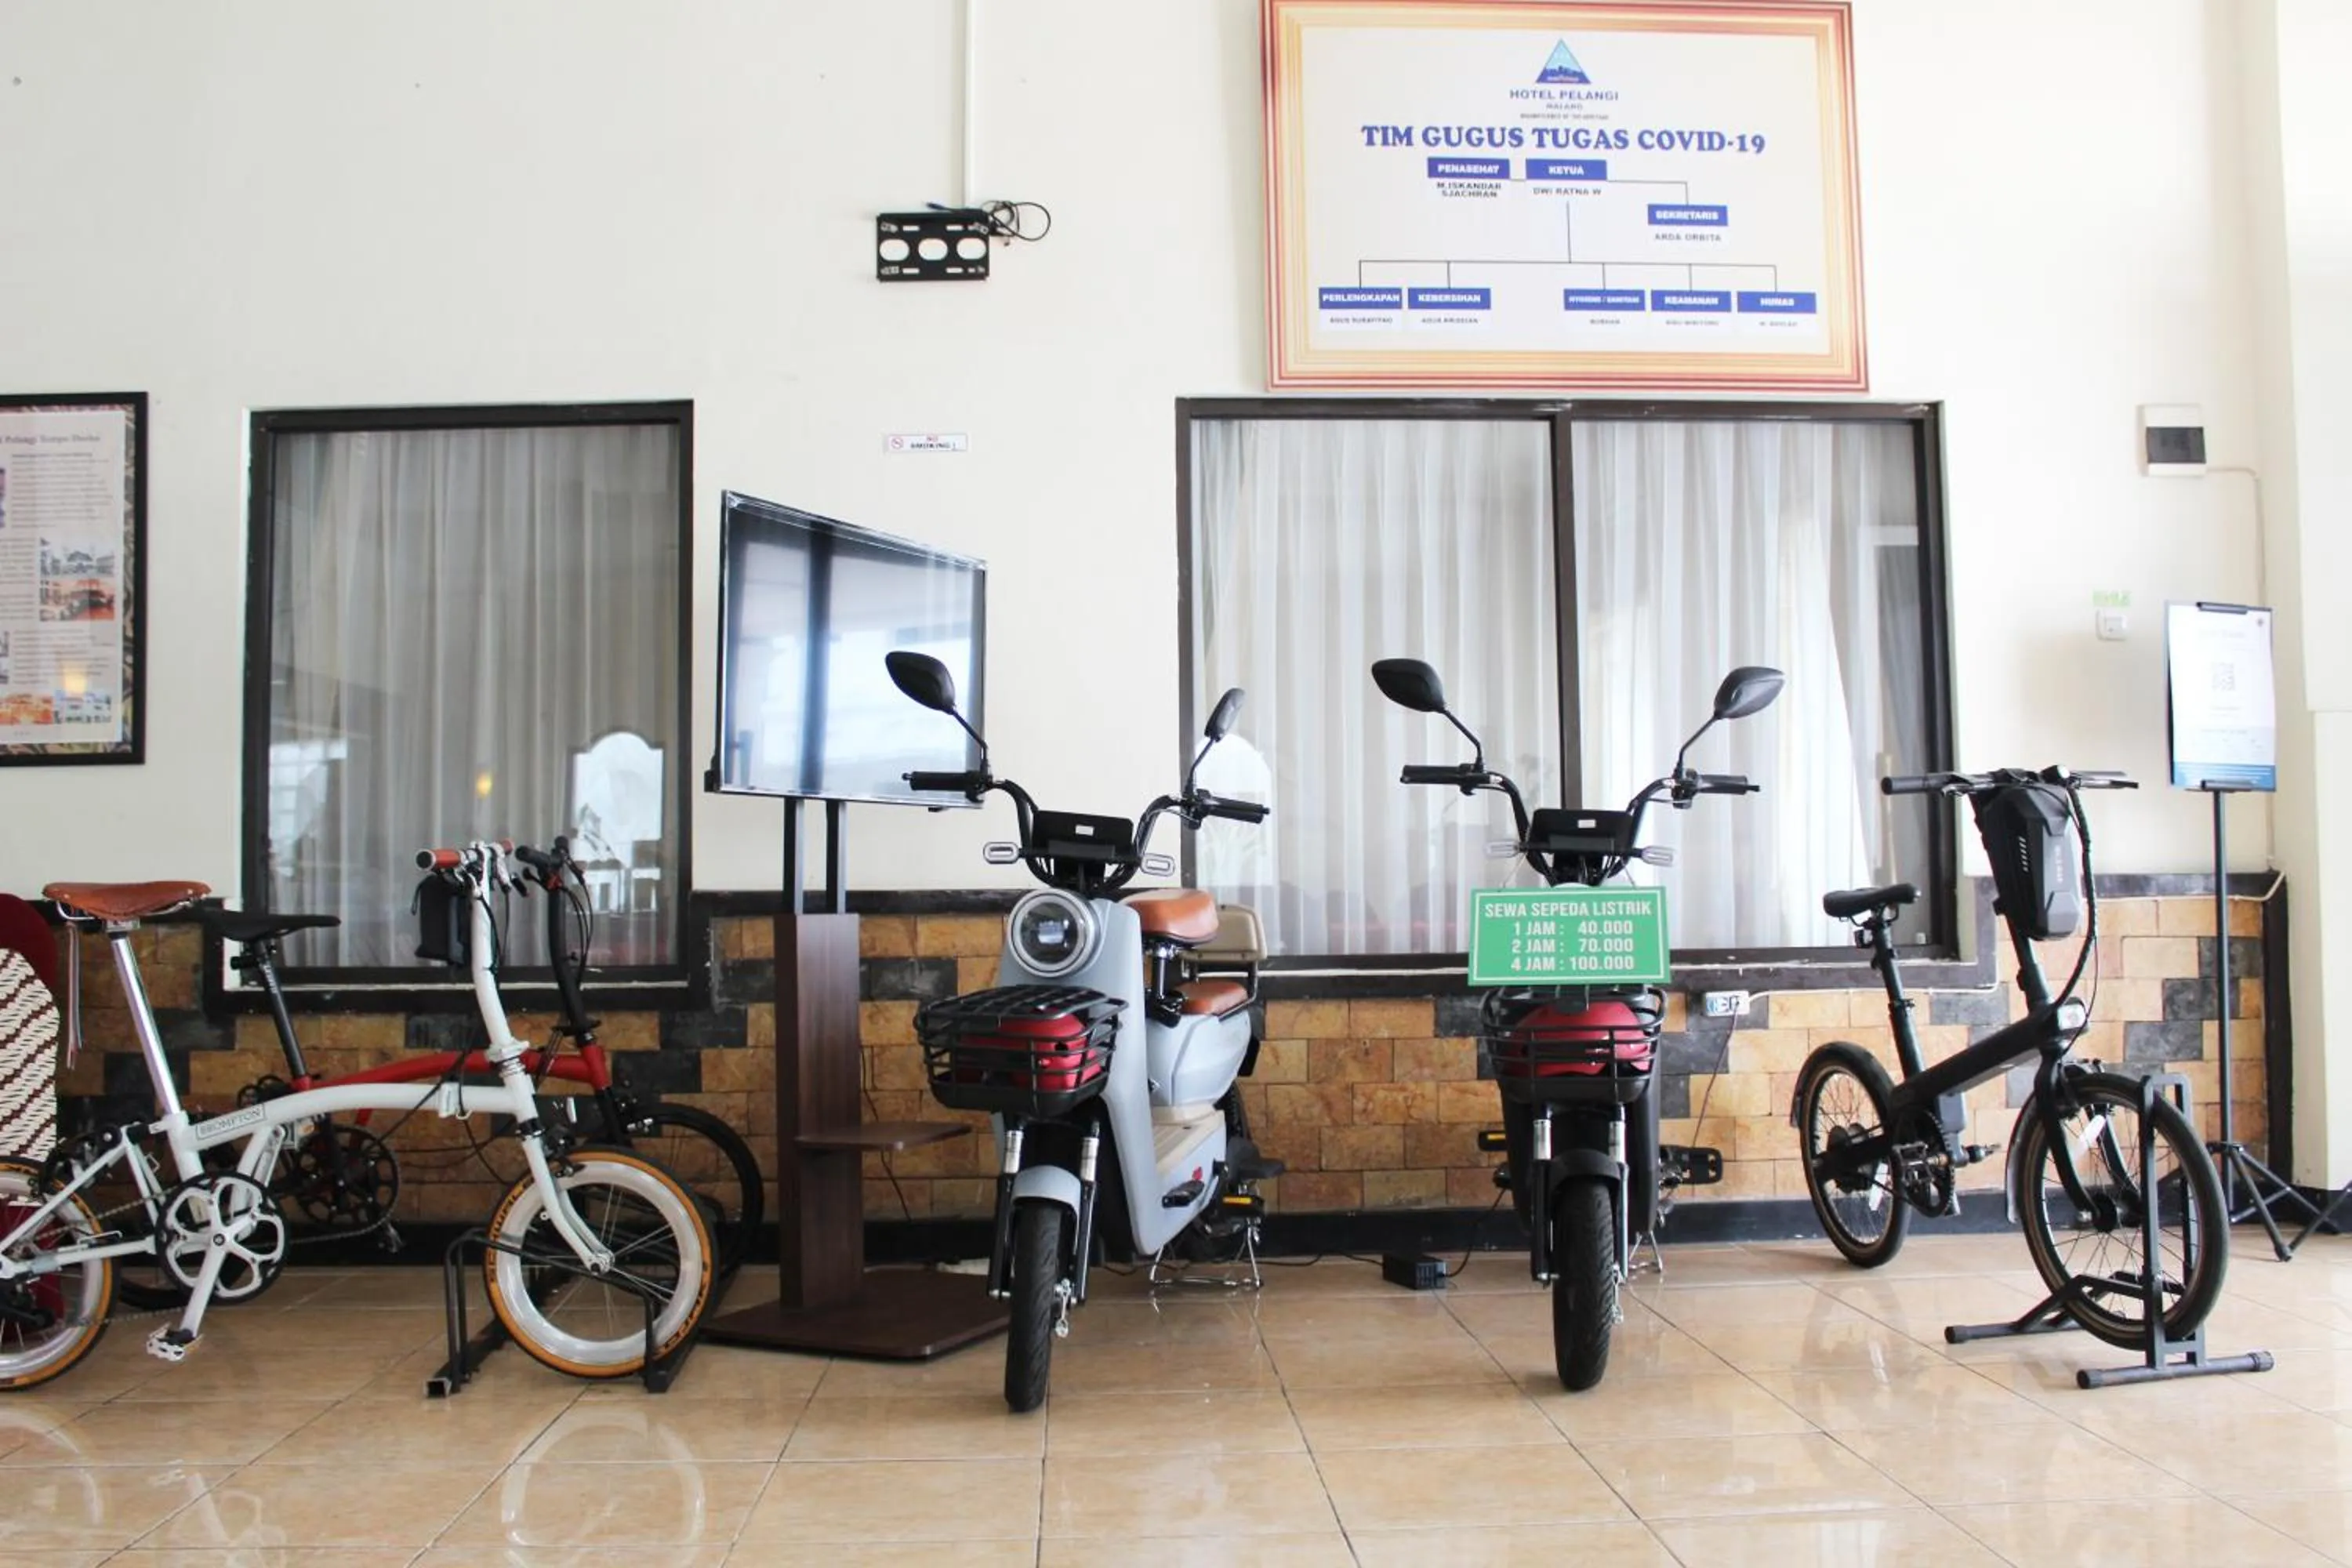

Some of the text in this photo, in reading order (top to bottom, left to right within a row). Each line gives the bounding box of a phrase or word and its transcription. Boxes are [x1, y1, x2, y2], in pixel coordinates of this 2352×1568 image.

[1509, 89, 1619, 101] HOTEL PELANGI
[1361, 125, 1766, 154] TIM GUGUS TUGAS COVID-19
[1437, 163, 1500, 175] PENASEHAT
[1548, 165, 1584, 176] KETUA
[1655, 210, 1719, 221] SEKRETARIS
[1322, 293, 1400, 303] PERLENGKAPAN
[1417, 293, 1482, 303] KEBERSIHAN
[1484, 901, 1652, 917] SEWA SEPEDA LISTRIK
[1514, 921, 1521, 936] 1
[1526, 921, 1555, 935] JAM
[1577, 920, 1634, 935] 40.000
[1511, 938, 1521, 953] 2
[1525, 938, 1555, 953] JAM
[1579, 938, 1635, 953] 70.000
[1511, 956, 1521, 971] 4
[1525, 956, 1555, 971] JAM
[1570, 956, 1635, 971] 100.000
